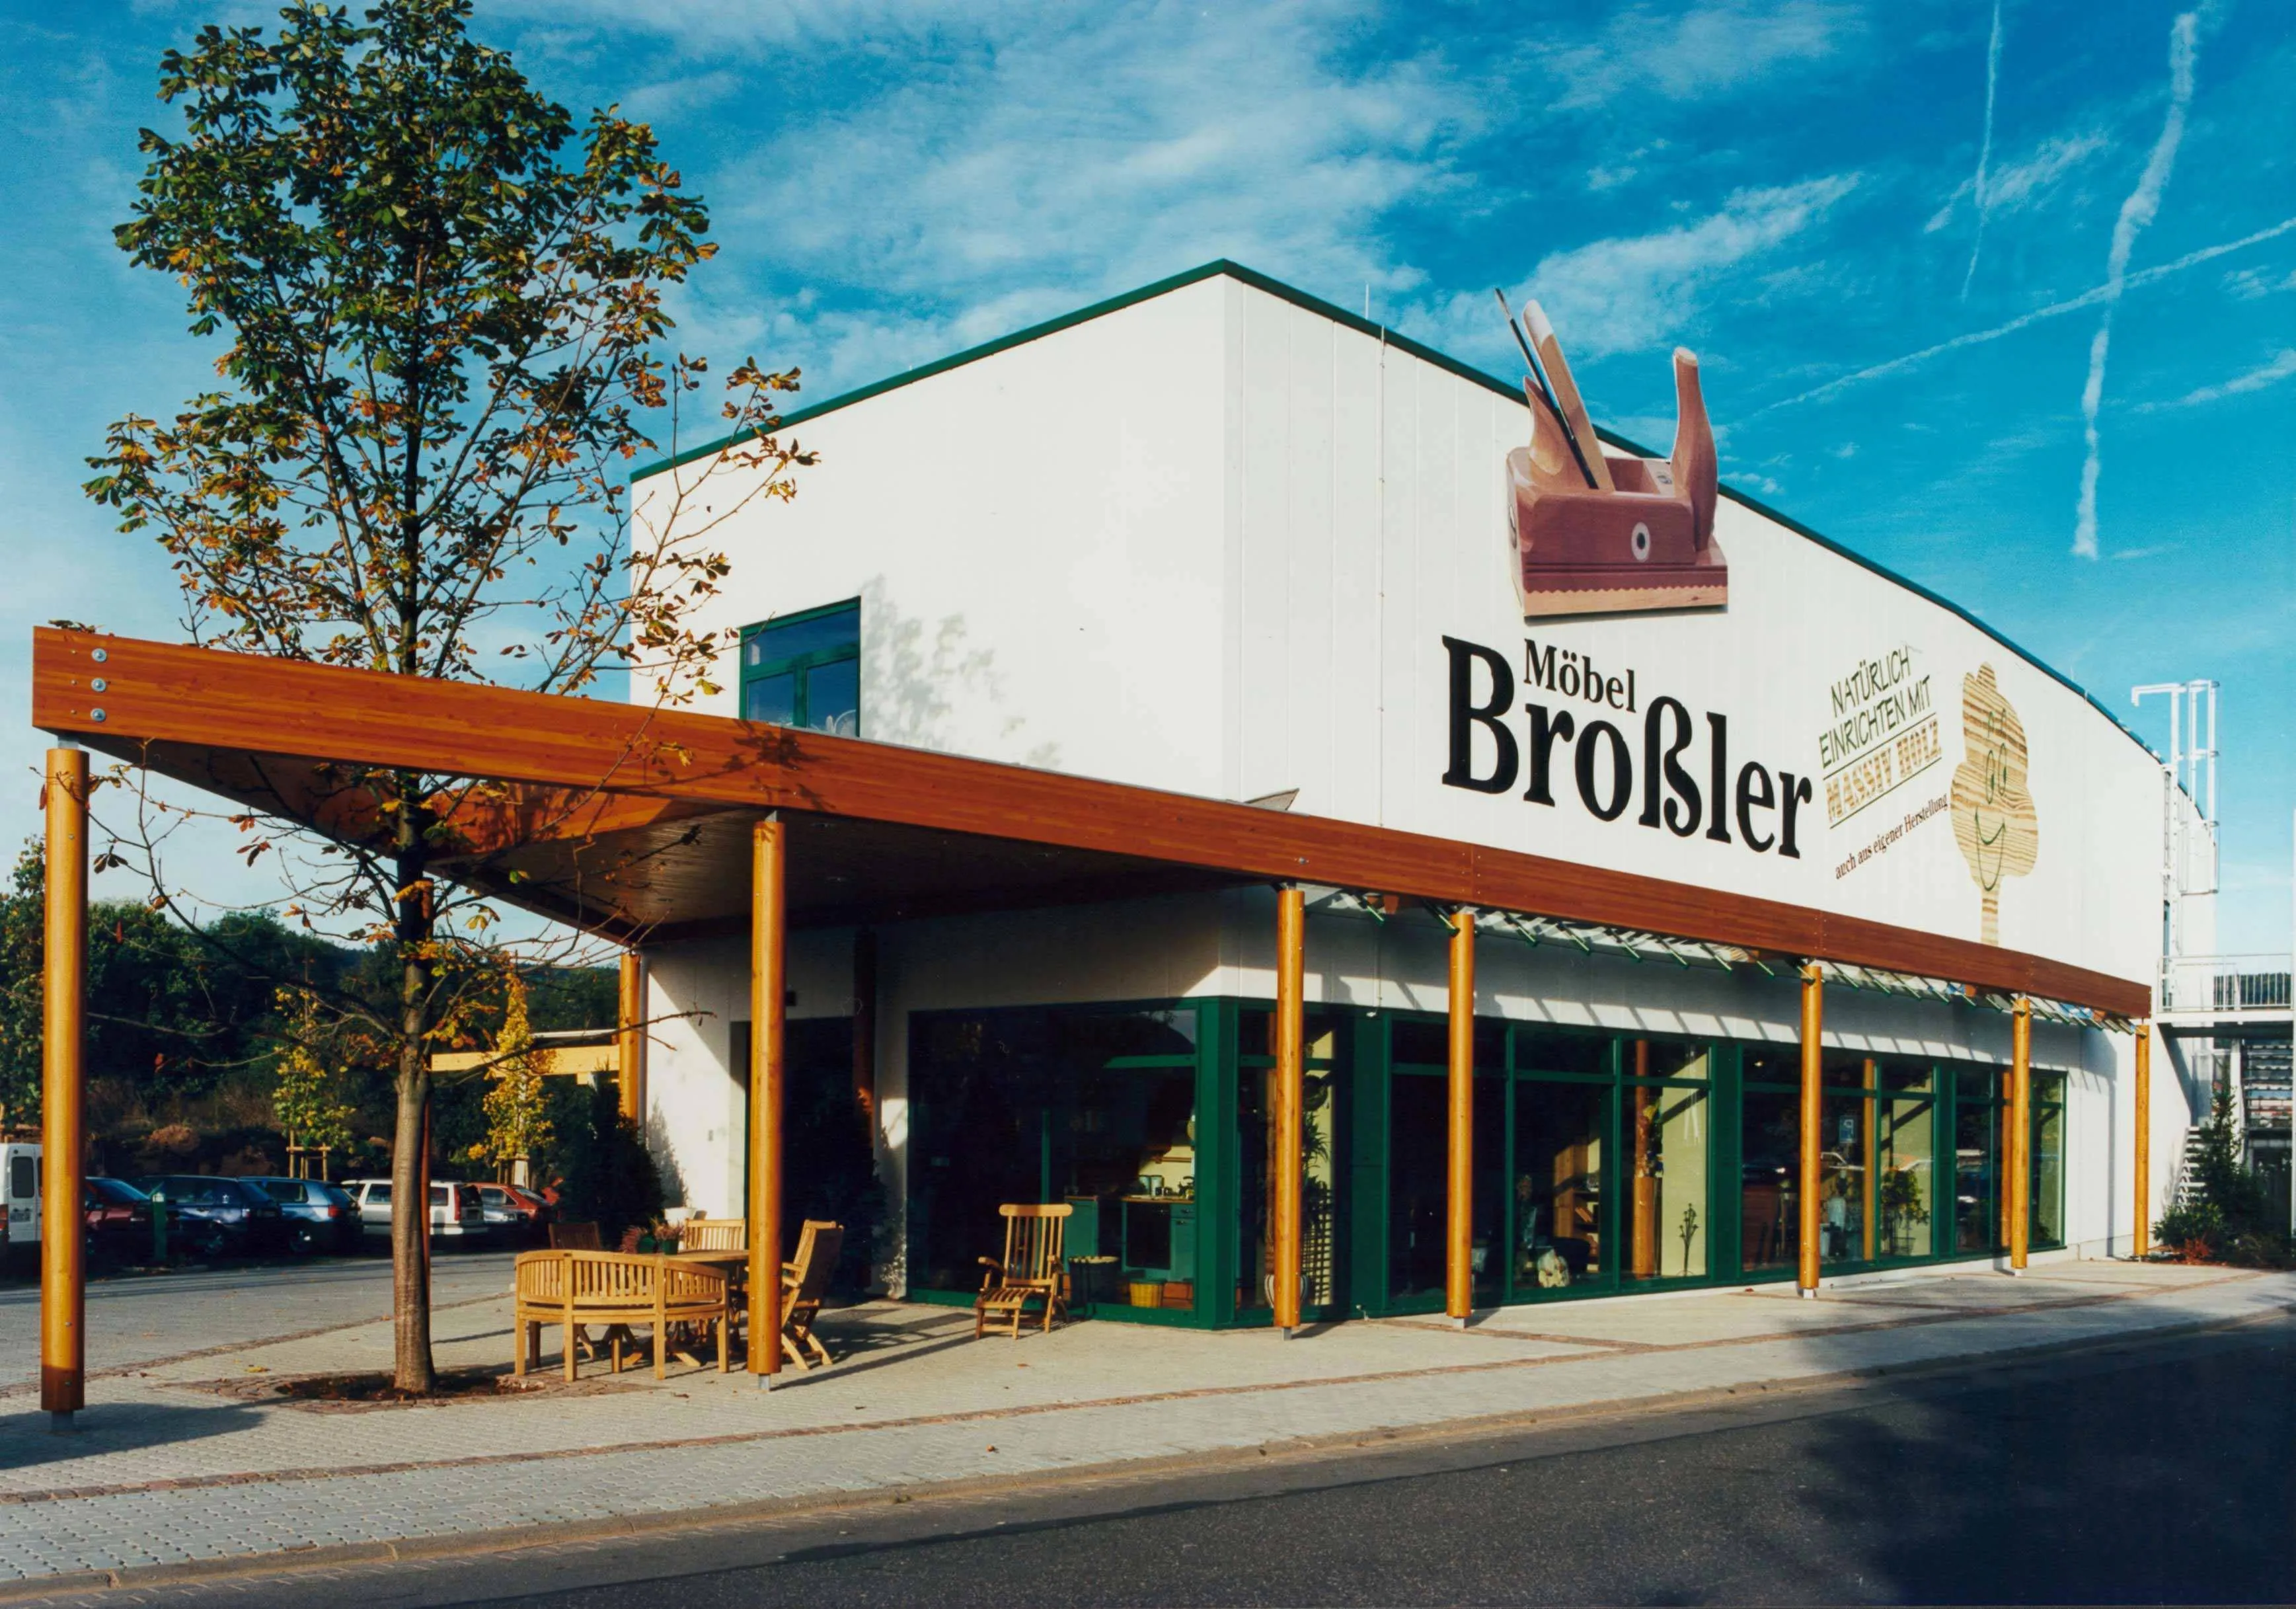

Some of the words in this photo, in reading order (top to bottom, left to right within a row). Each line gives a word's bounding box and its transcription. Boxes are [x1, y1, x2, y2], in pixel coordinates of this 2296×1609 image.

[1523, 639, 1636, 713] Möbel
[1819, 690, 1906, 769] EINRICHTEN
[1907, 674, 1931, 717] MIT
[1831, 645, 1911, 719] NATÜRLICH
[1441, 635, 1813, 859] Broßler
[1825, 748, 1892, 823] MASSIV
[1896, 719, 1942, 777] HOLZ
[1835, 853, 1856, 880] auch
[1857, 845, 1872, 865] aus
[1873, 824, 1903, 854] eigener
[1904, 793, 1948, 833] Herstellung
